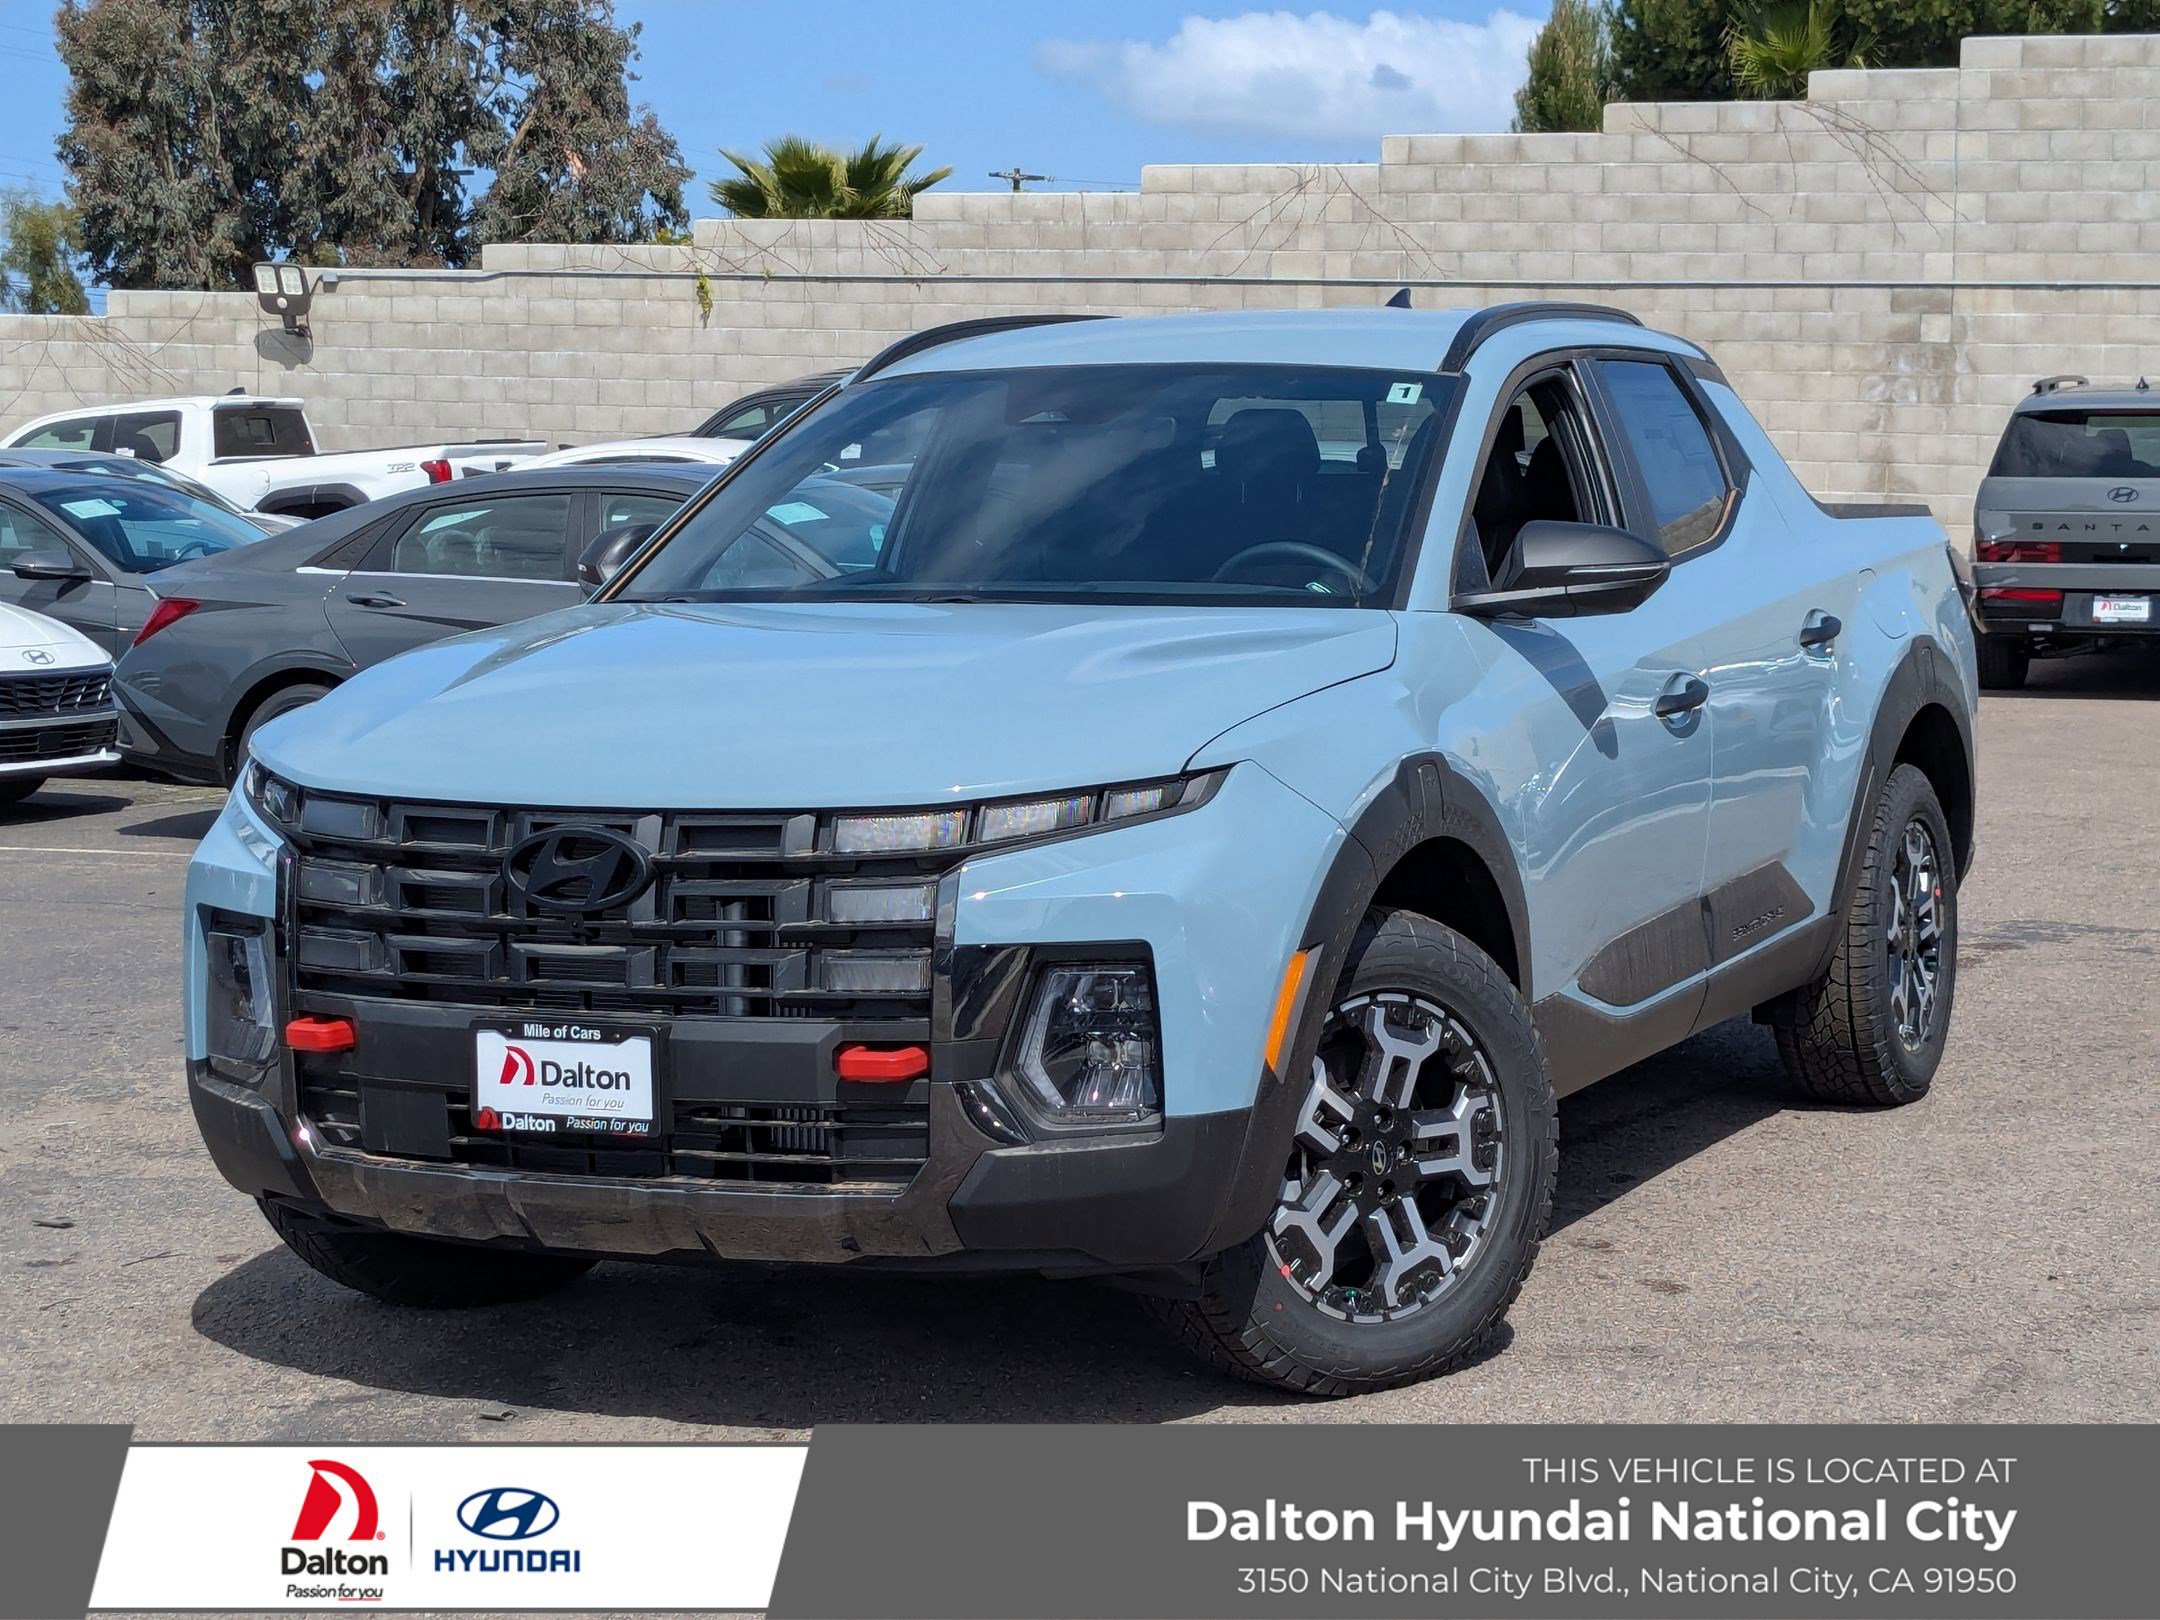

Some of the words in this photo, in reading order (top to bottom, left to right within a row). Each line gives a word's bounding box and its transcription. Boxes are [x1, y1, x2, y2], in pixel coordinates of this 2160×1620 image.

[2031, 522, 2150, 532] SANTA
[523, 1023, 551, 1038] Mile
[553, 1026, 568, 1038] of
[570, 1027, 602, 1040] Cars
[540, 1060, 631, 1091] Dalton
[541, 1092, 583, 1107] Passion
[585, 1094, 602, 1108] for
[602, 1098, 625, 1110] you
[501, 1112, 556, 1132] Dalton
[565, 1115, 607, 1130] Passion
[609, 1118, 627, 1132] for
[627, 1120, 650, 1134] you
